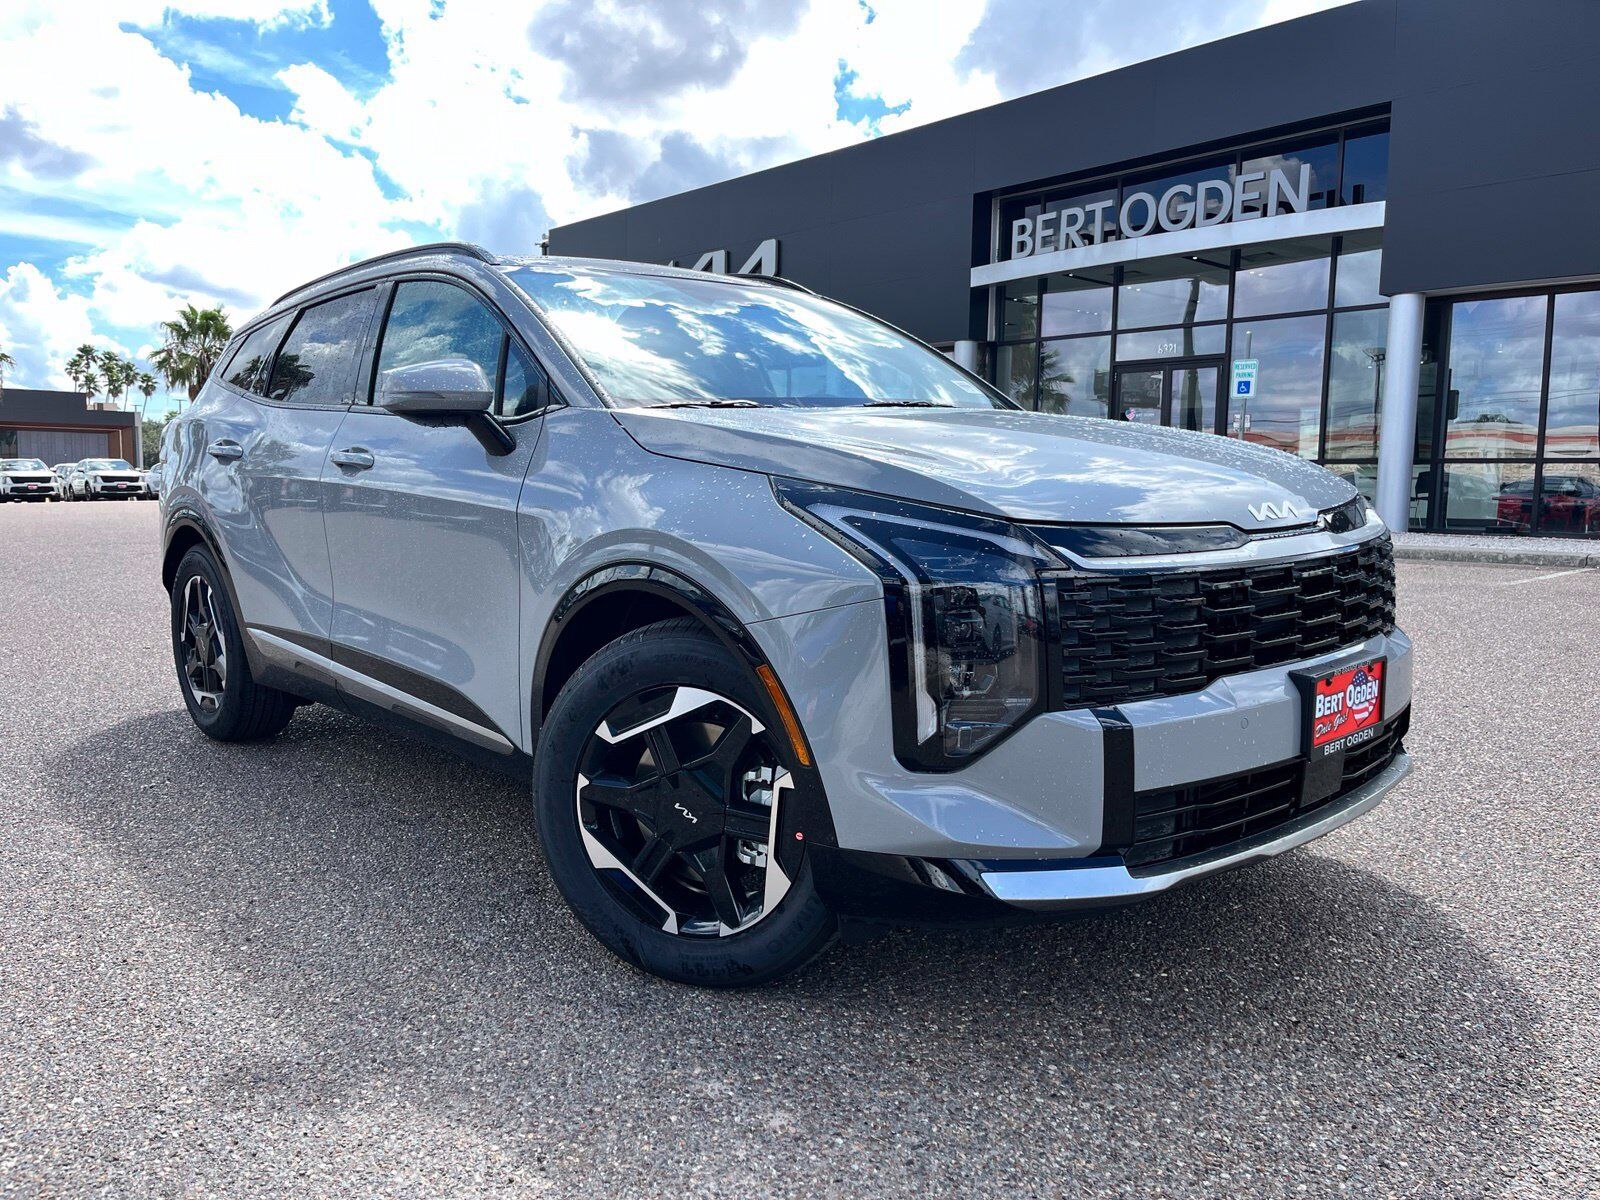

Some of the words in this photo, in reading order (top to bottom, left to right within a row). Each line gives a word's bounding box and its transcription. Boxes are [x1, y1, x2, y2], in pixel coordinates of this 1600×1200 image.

[1011, 199, 1114, 260] BERT
[1119, 163, 1312, 239] OGDEN
[1247, 500, 1298, 521] KIA
[1315, 691, 1344, 719] BERT
[1346, 680, 1378, 708] OGDEN
[1324, 740, 1345, 756] BERT
[1346, 727, 1374, 747] OGDEN
